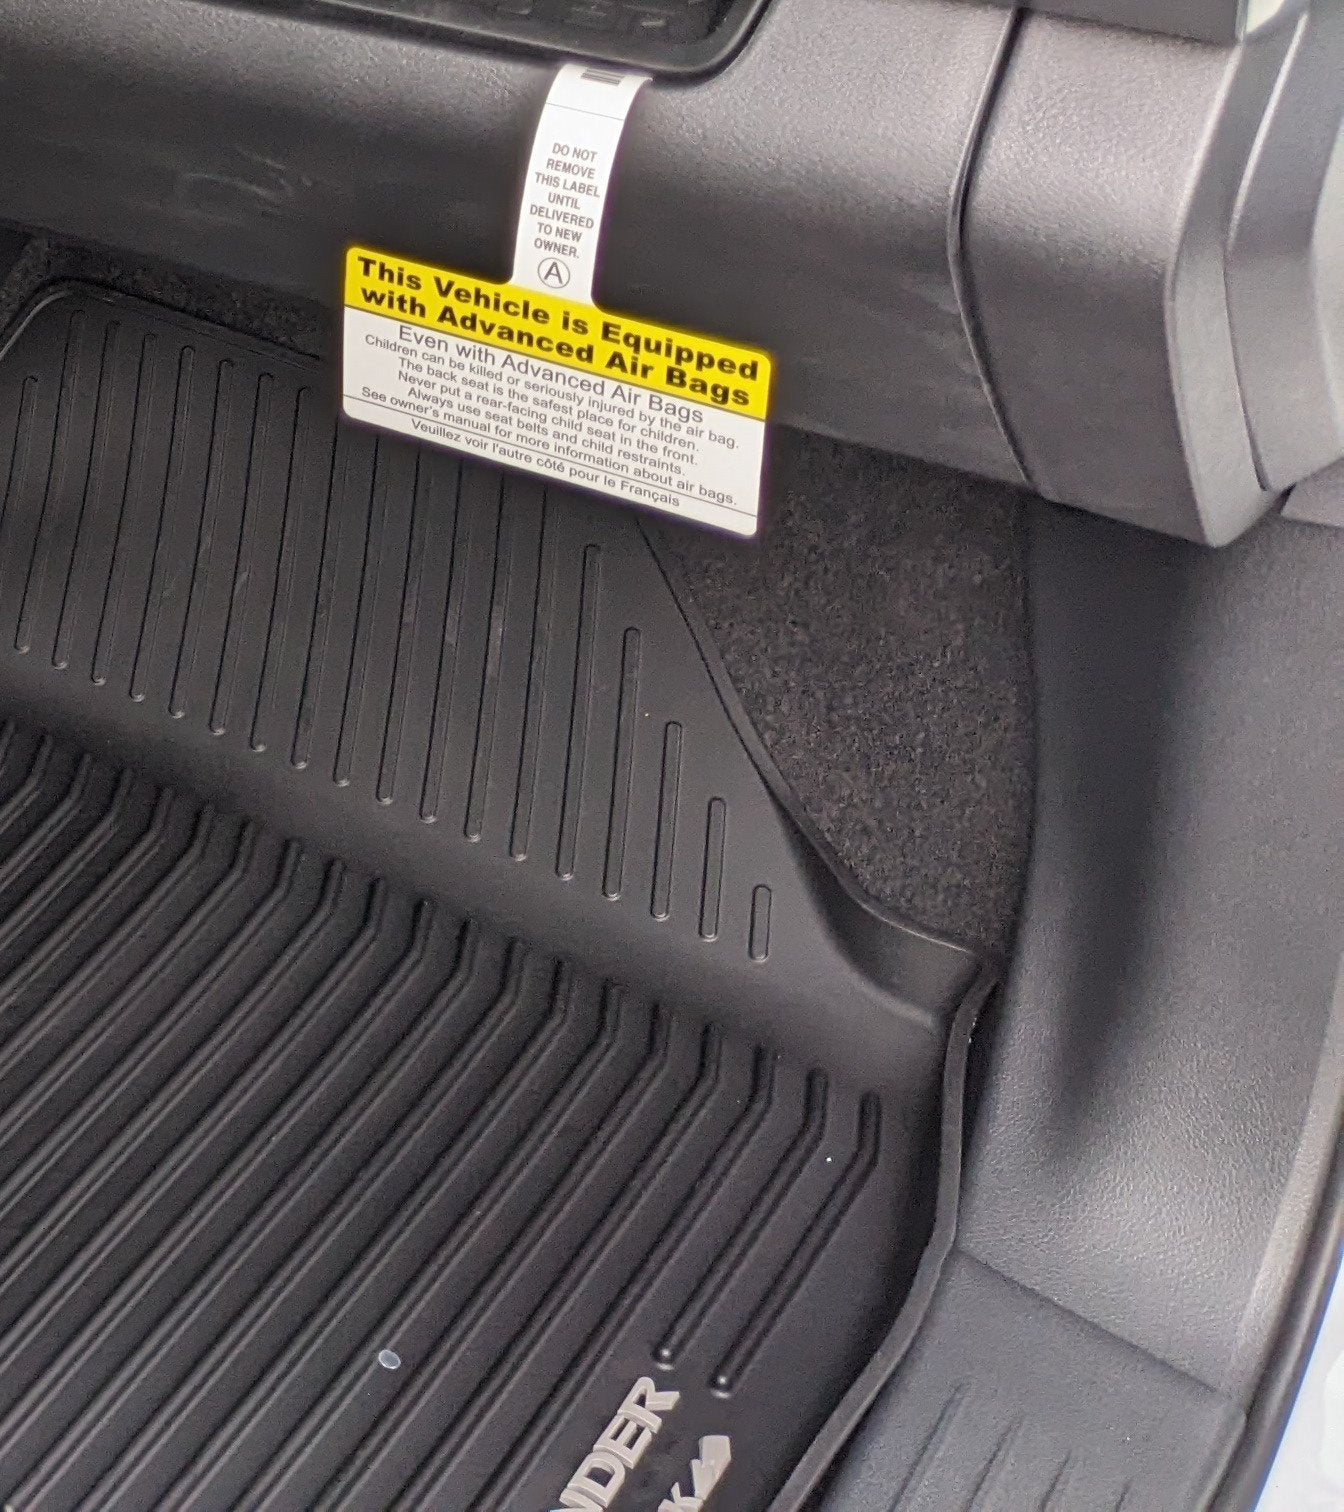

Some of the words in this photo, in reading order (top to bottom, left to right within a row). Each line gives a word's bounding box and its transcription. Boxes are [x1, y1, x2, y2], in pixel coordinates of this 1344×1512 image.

[535, 171, 560, 189] THIS
[563, 179, 600, 199] LABEL
[546, 158, 596, 180] REMOVE
[552, 142, 570, 156] DO
[572, 147, 598, 163] NOT
[529, 204, 595, 229] DELIVERED
[537, 222, 553, 236] TO
[555, 226, 583, 243] NEW
[548, 192, 581, 210] UNTIL
[534, 237, 580, 259] OWNER.
[357, 256, 422, 291] This
[434, 276, 550, 324] Vehicle
[562, 311, 588, 335] is
[601, 321, 758, 381] Equipped
[361, 287, 426, 318] with
[437, 305, 594, 364] Advanced
[605, 351, 654, 379] Air
[665, 365, 749, 406] Bags
[365, 333, 418, 360] Children
[421, 352, 445, 366] can
[448, 356, 465, 371] be
[469, 362, 503, 382] killed
[506, 376, 521, 386] or
[524, 380, 585, 407] seriously
[588, 396, 635, 419] injured
[638, 410, 656, 427] by
[660, 416, 683, 432] the
[686, 423, 706, 438] air
[708, 430, 740, 451] bag.
[398, 356, 423, 373] The
[426, 364, 458, 383] back
[461, 376, 489, 392] seat
[493, 383, 504, 396] is
[508, 388, 529, 403] the
[532, 397, 573, 416] safest
[577, 409, 614, 427] place
[618, 418, 637, 433] for
[640, 427, 699, 452] children.
[398, 370, 437, 390] Never
[440, 384, 461, 398] put
[464, 391, 473, 401] a
[476, 394, 548, 425] rear-facing
[551, 416, 583, 433] child
[586, 426, 616, 443] seat
[620, 433, 632, 447] in
[636, 438, 658, 454] the
[662, 445, 698, 465] front.
[399, 324, 449, 353] Even
[455, 343, 496, 366] with
[500, 353, 605, 397] Advanced
[610, 384, 642, 406] Air
[648, 393, 703, 423] Bags
[361, 386, 387, 403] See
[389, 396, 441, 418] owner's
[443, 412, 491, 433] manual
[494, 424, 513, 439] for
[516, 433, 550, 450] more
[553, 441, 629, 474] information
[633, 467, 673, 487] about
[676, 480, 695, 492] air
[698, 484, 737, 505] bags.
[407, 386, 454, 409] Always
[457, 403, 481, 417] use
[484, 410, 513, 427] seat
[516, 417, 549, 436] belts
[552, 430, 578, 445] and
[581, 438, 614, 455] child
[617, 449, 685, 476] restraints.
[411, 418, 461, 443] Veuillez
[464, 436, 489, 451] voir
[492, 442, 533, 464] l'autre
[536, 457, 565, 473] côté
[569, 467, 600, 483] pour
[603, 474, 616, 488] le
[620, 480, 680, 507] Français
